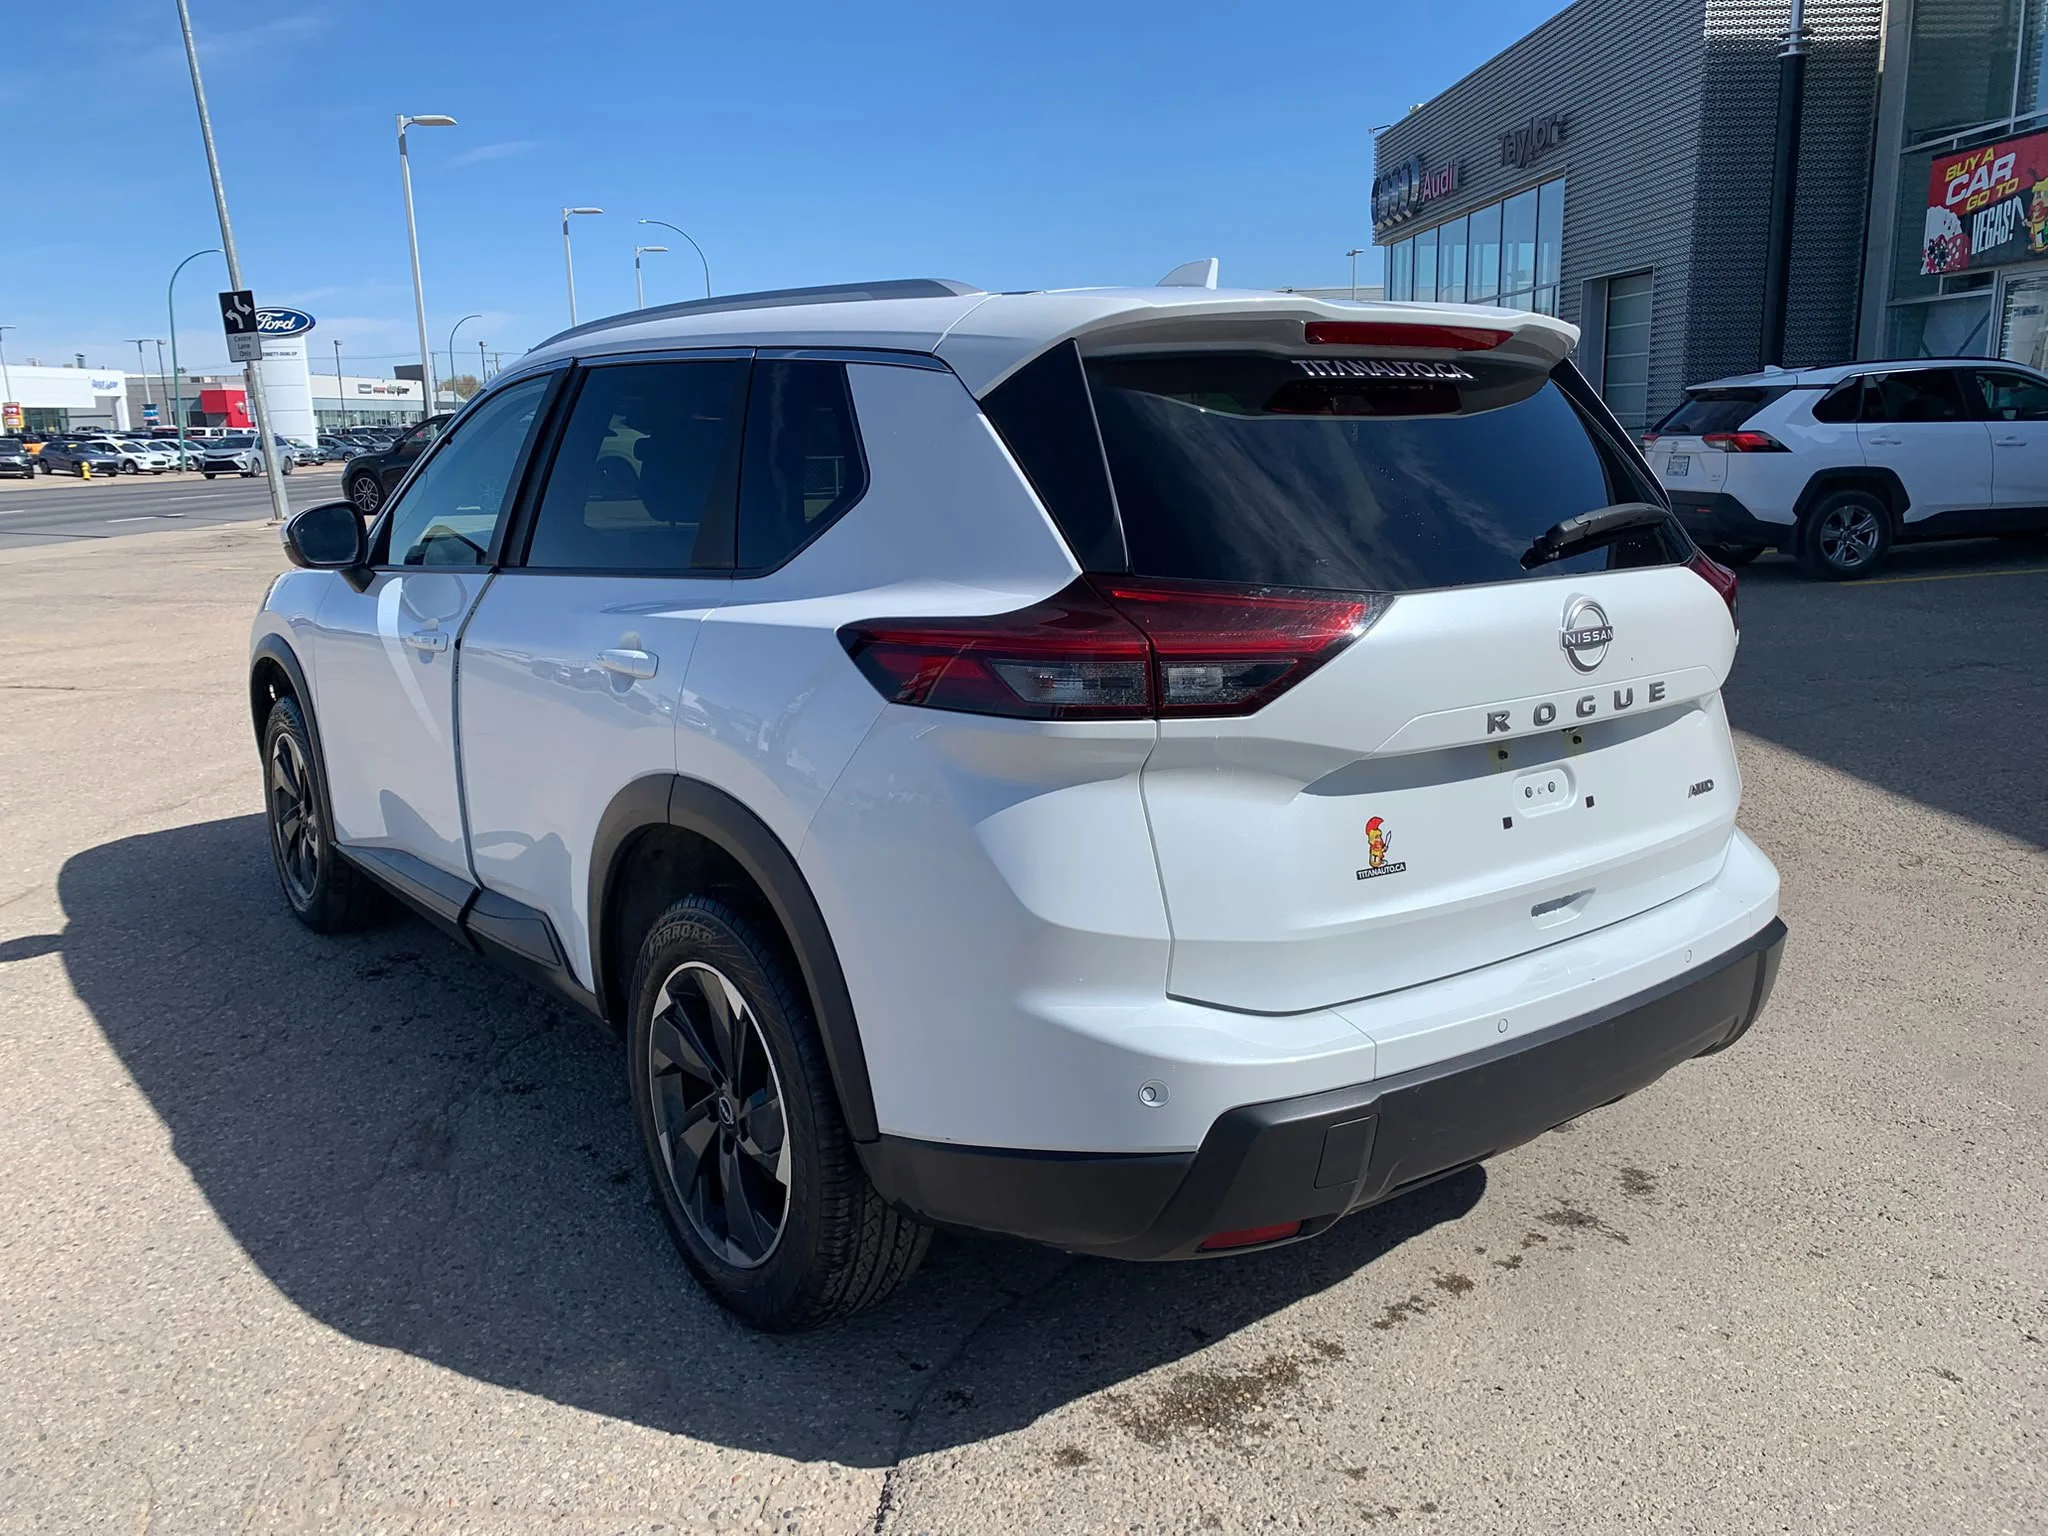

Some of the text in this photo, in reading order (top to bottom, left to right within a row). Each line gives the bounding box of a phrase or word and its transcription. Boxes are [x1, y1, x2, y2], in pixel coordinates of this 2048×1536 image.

[1421, 159, 1460, 202] Audi
[1945, 147, 1995, 182] BUY A
[1945, 152, 2016, 206] CAR
[1966, 177, 2019, 211] GO TO
[1971, 196, 2018, 255] VEGAS!
[256, 312, 296, 330] Ford
[1291, 359, 1475, 379] TITANAUTO.CA
[1565, 628, 1613, 645] NISSAN
[1486, 680, 1666, 735] ROGUE
[1687, 778, 1715, 799] AWD
[1357, 863, 1405, 879] TITANAUTO.CA
